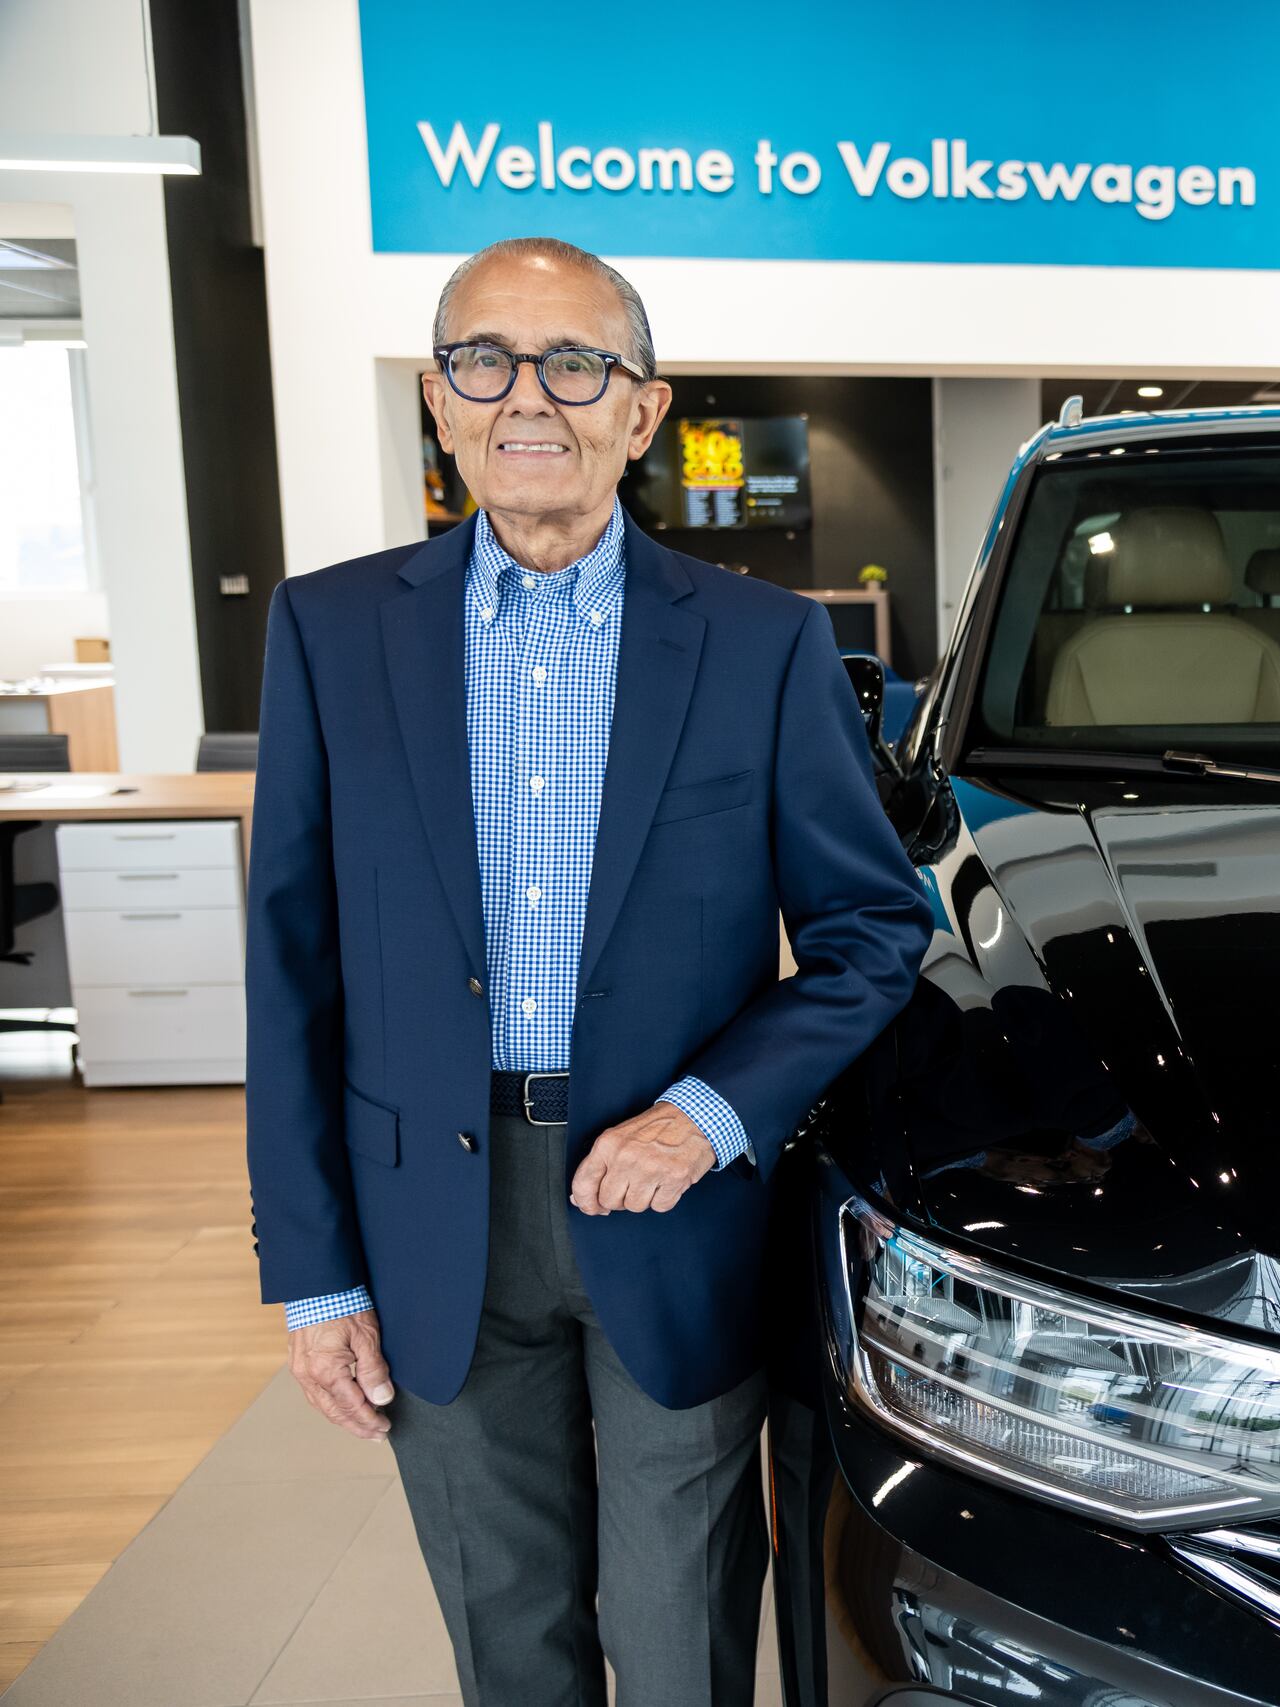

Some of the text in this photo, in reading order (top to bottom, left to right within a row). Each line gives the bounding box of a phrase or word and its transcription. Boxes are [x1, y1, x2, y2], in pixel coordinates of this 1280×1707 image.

[417, 121, 1258, 221] Welcome to Volkswagen
